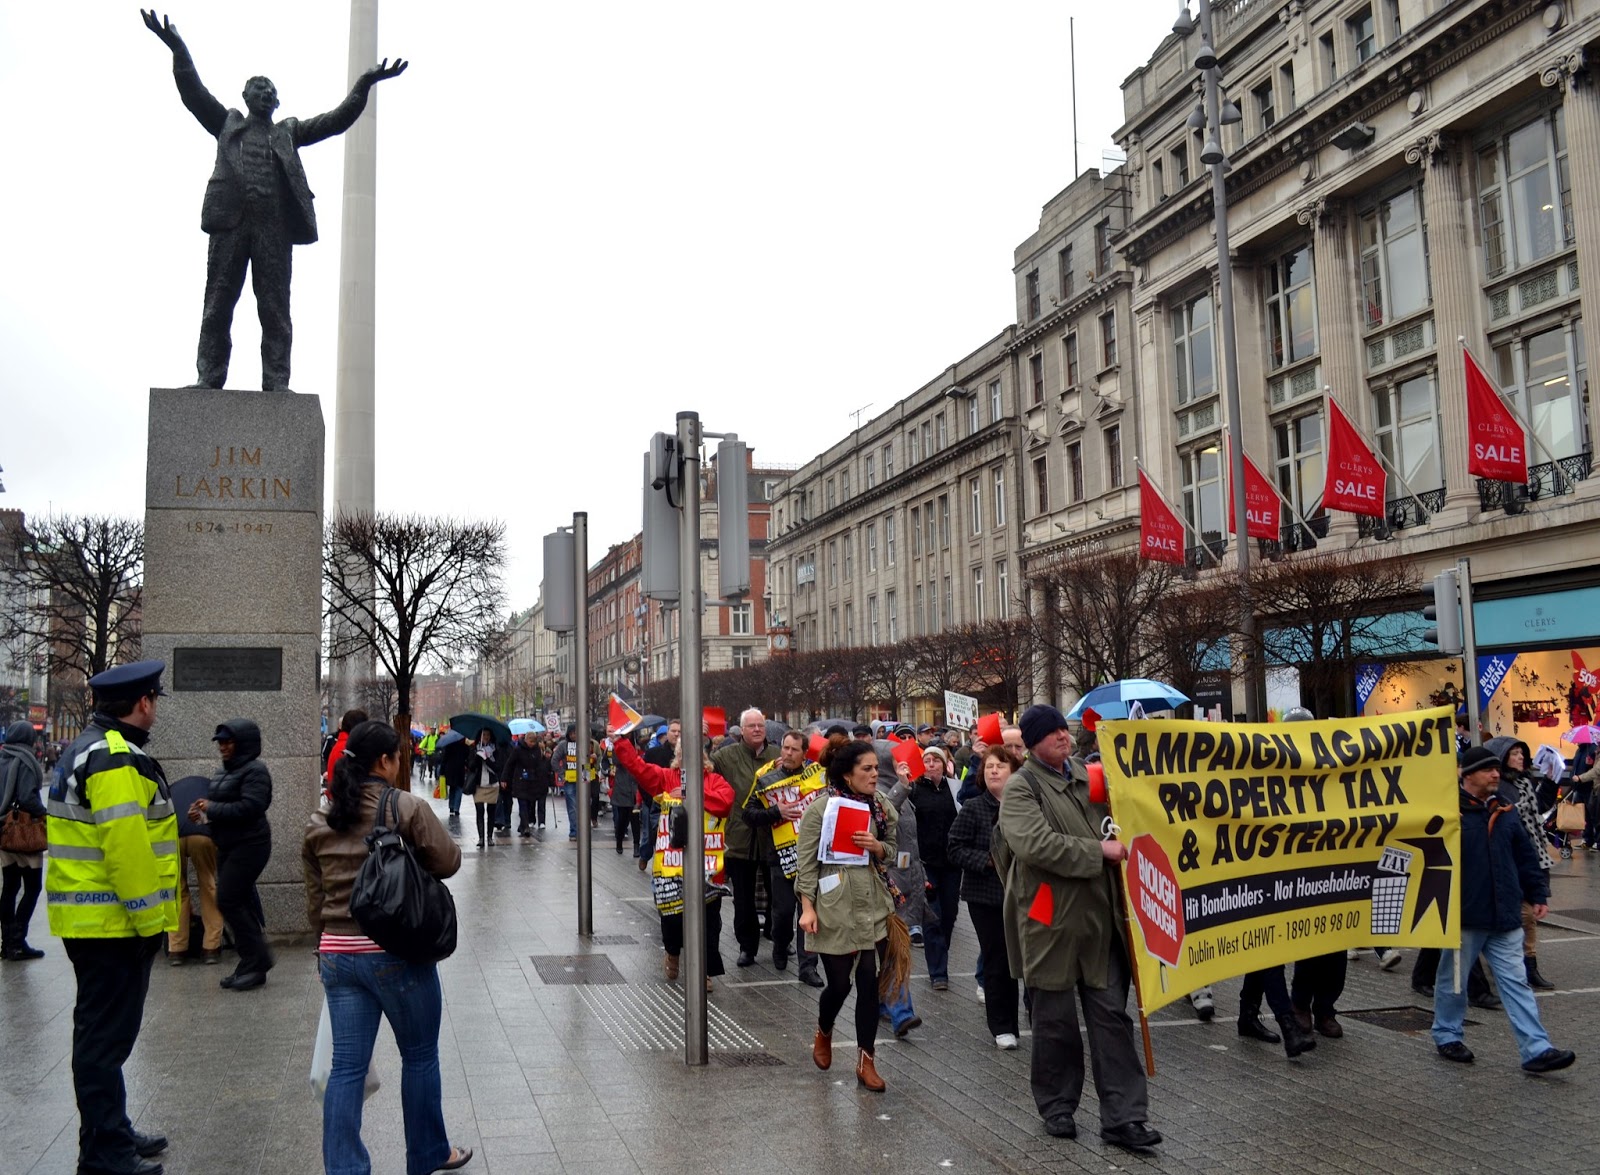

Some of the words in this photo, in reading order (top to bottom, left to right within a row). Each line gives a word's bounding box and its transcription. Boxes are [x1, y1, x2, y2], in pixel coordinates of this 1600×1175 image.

[1477, 422, 1514, 435] CLERYS
[209, 446, 262, 469] JIM
[1474, 442, 1521, 464] SALE
[1339, 461, 1373, 475] CLERYS
[175, 475, 291, 499] LARKIN
[1246, 492, 1269, 502] LERYS
[1334, 479, 1377, 500] SALE
[1246, 509, 1272, 525] ALE
[1146, 535, 1178, 552] SALE
[1524, 618, 1556, 628] CLERYS
[1478, 666, 1494, 688] BLUE
[1492, 656, 1500, 665] X
[1483, 660, 1508, 698] EVENT
[1113, 730, 1302, 779] CAMPAIGN
[1310, 715, 1453, 770] AGAINST
[1159, 775, 1329, 824] PROPERTY
[1339, 765, 1408, 809] TAX
[1177, 829, 1200, 873] &
[1211, 812, 1399, 866] AUSTERITY
[1381, 853, 1409, 873] TAX
[1137, 849, 1177, 915] ENOUGH
[75, 892, 119, 904] GARDA
[122, 898, 148, 910] RDA
[1185, 897, 1200, 922] Hit
[1201, 884, 1264, 916] Bondholders
[1274, 880, 1294, 901] Not
[1296, 869, 1371, 898] Householders
[1188, 938, 1215, 967] Dublin
[1217, 934, 1240, 956] West
[1242, 924, 1276, 951] CAHWT
[1285, 918, 1311, 941] 1890
[1313, 915, 1327, 935] 98
[1330, 912, 1343, 932] 98
[1345, 910, 1360, 929] 00
